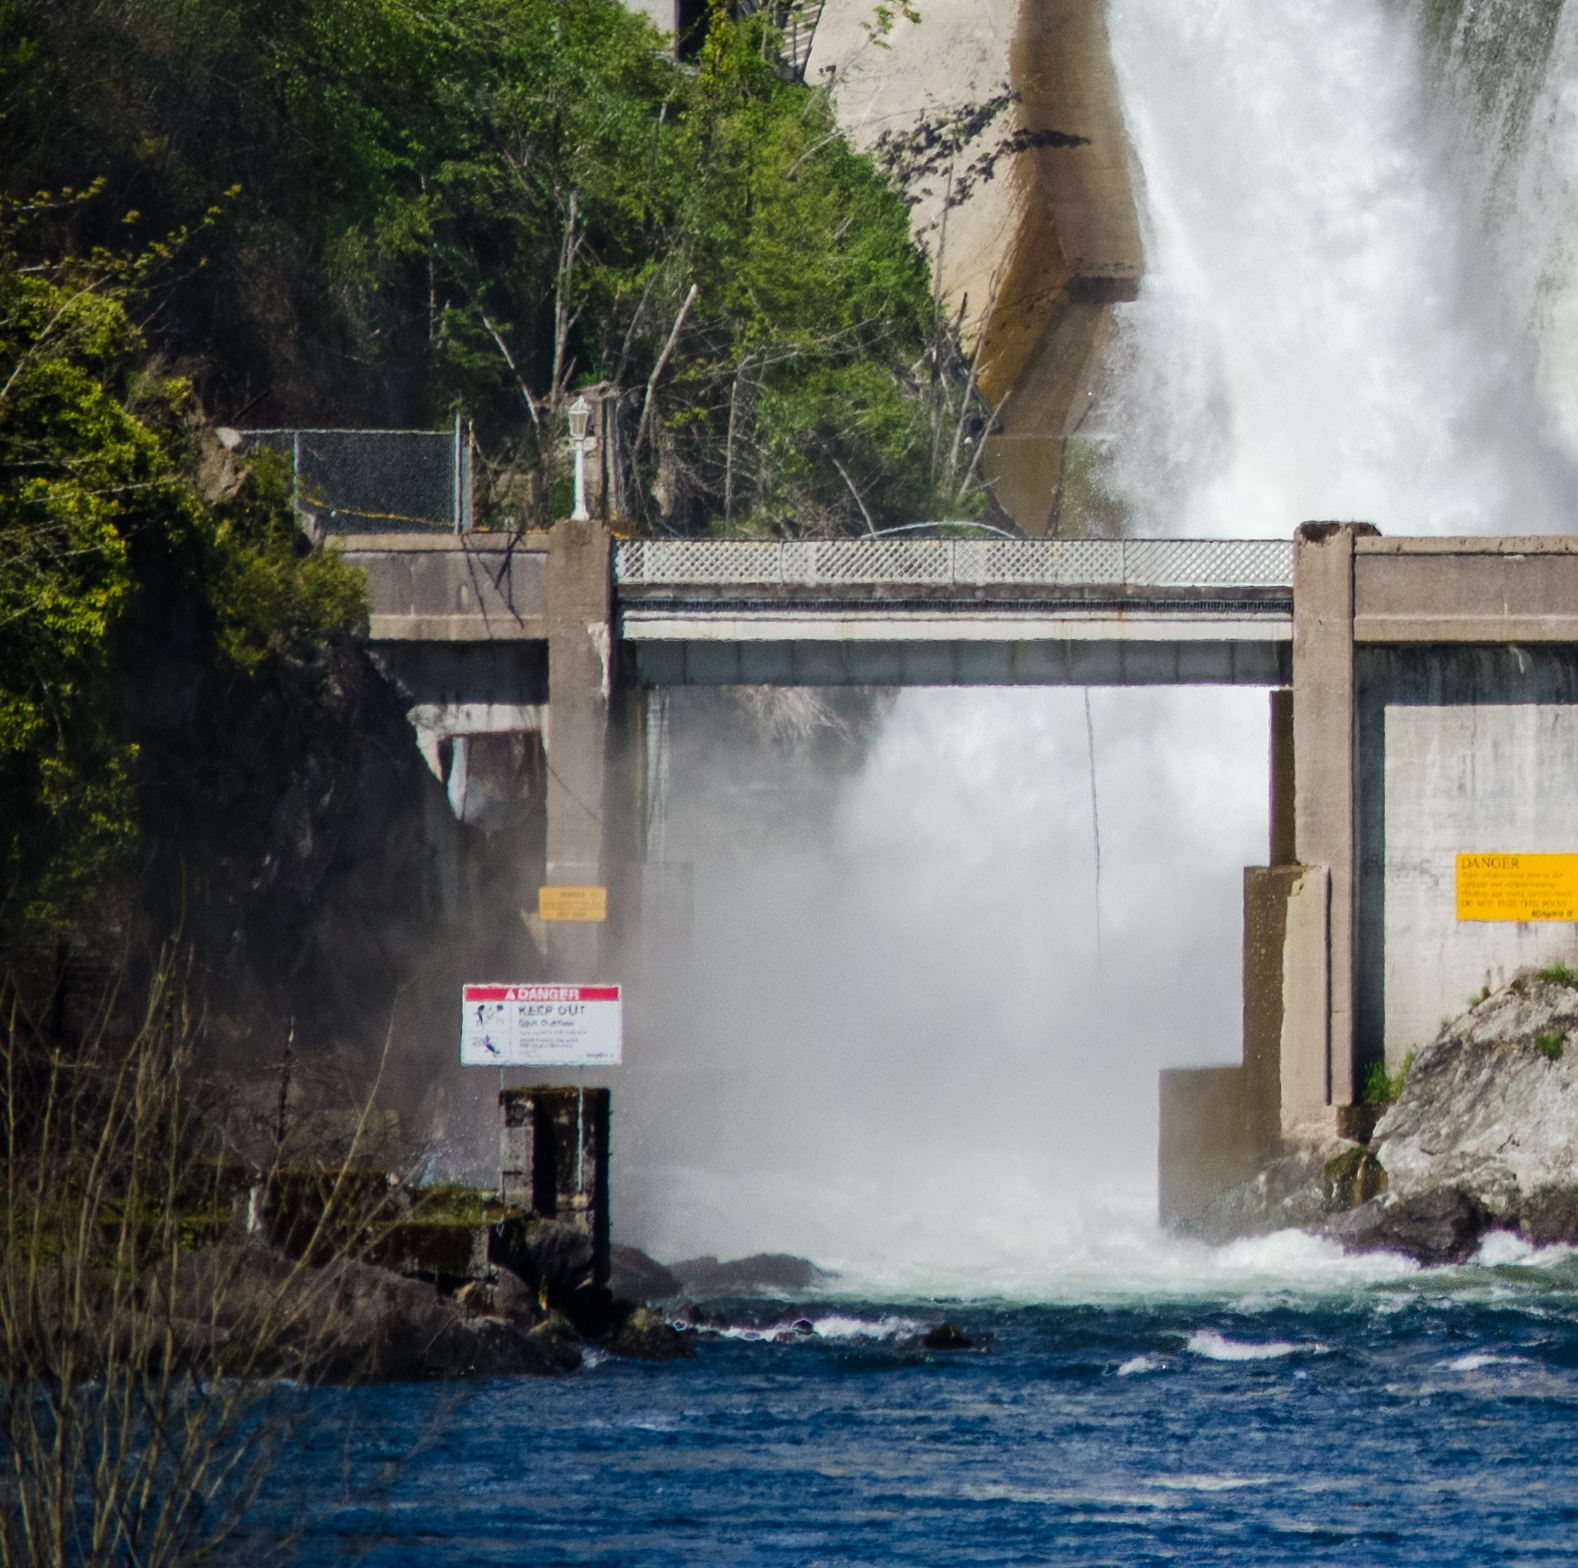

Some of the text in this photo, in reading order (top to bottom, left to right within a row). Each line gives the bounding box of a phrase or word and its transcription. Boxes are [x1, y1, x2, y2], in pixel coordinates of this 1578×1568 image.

[1461, 857, 1519, 869] DANGER
[517, 988, 580, 1000] DANGER
[518, 1005, 585, 1016] KEEP OUT
